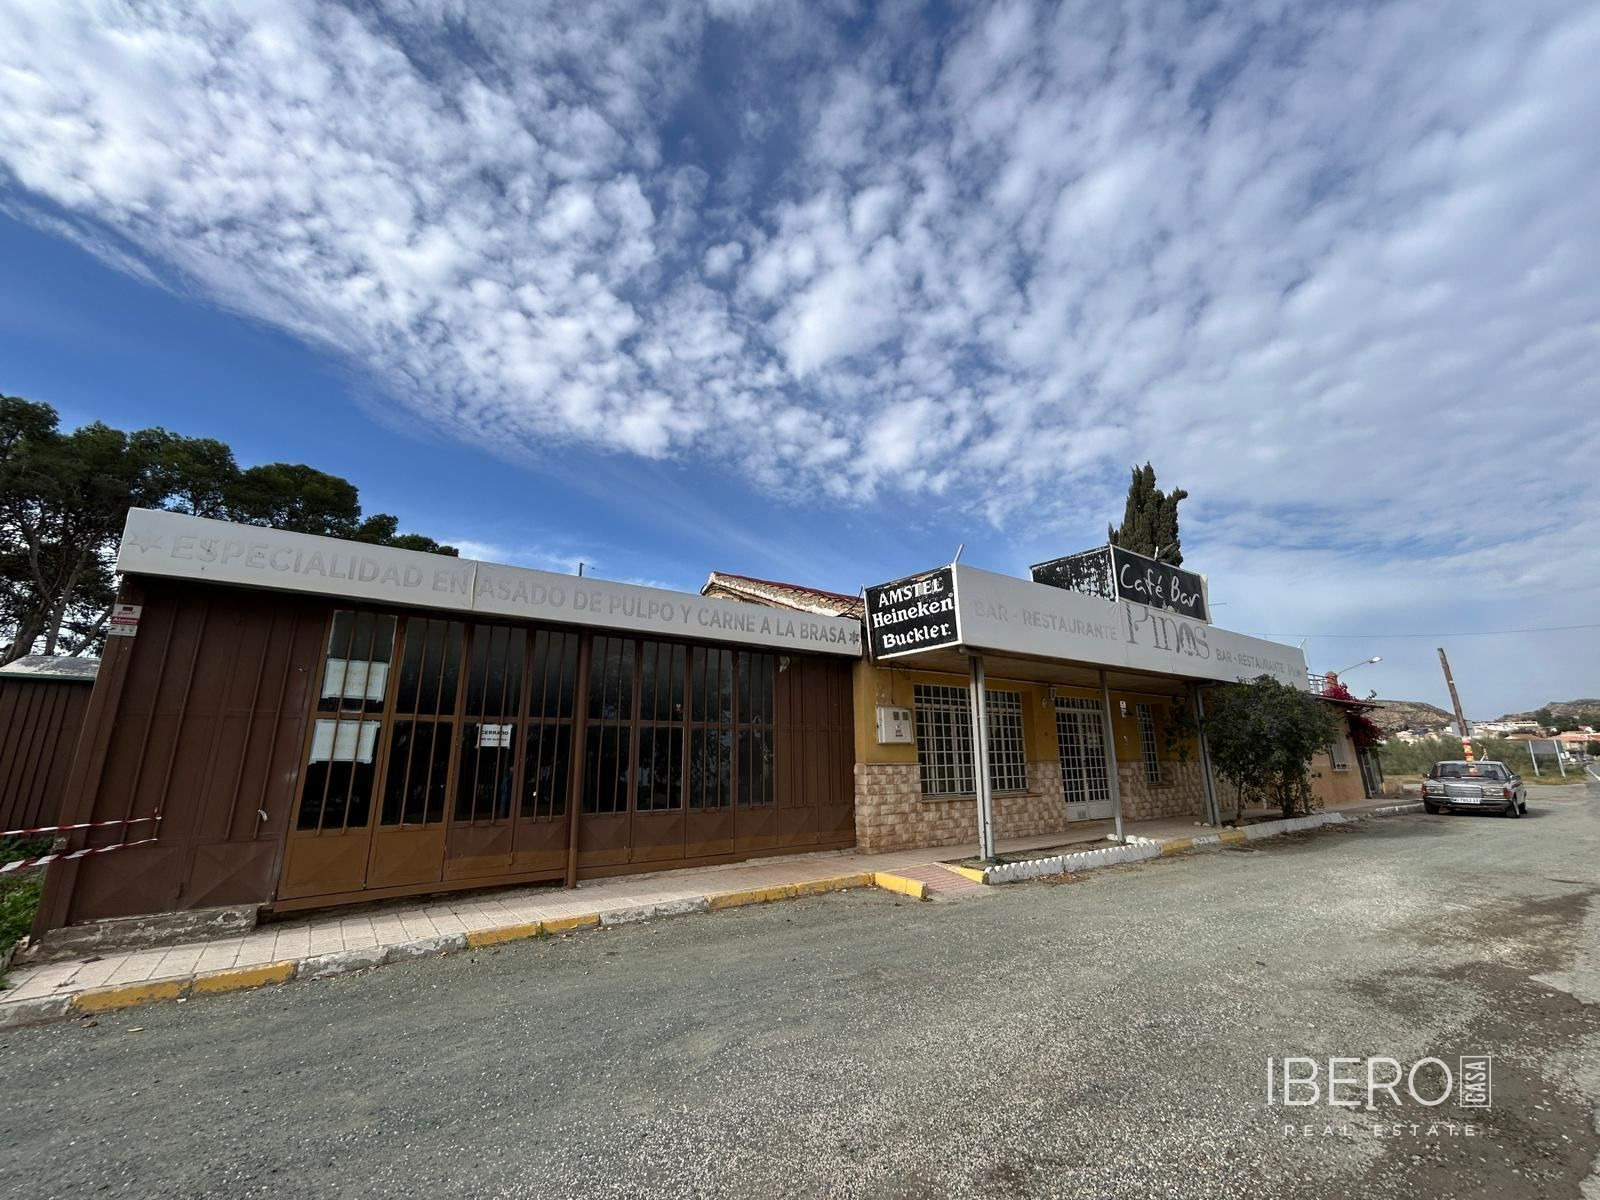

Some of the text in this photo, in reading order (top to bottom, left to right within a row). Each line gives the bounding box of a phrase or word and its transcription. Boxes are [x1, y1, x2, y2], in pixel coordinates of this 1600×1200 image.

[170, 535, 847, 645] ESPECIALIDAD EN ASADO DE PULPO Y CARNE A LA BRASA
[879, 578, 944, 608] AMSTEL
[1120, 563, 1200, 607] Café Bar
[872, 597, 954, 628] Heineken
[974, 600, 1009, 622] BAR
[1022, 608, 1118, 641] RESTAURANTE
[1216, 648, 1232, 663] BAR
[1238, 652, 1285, 674] RESTAURANTE
